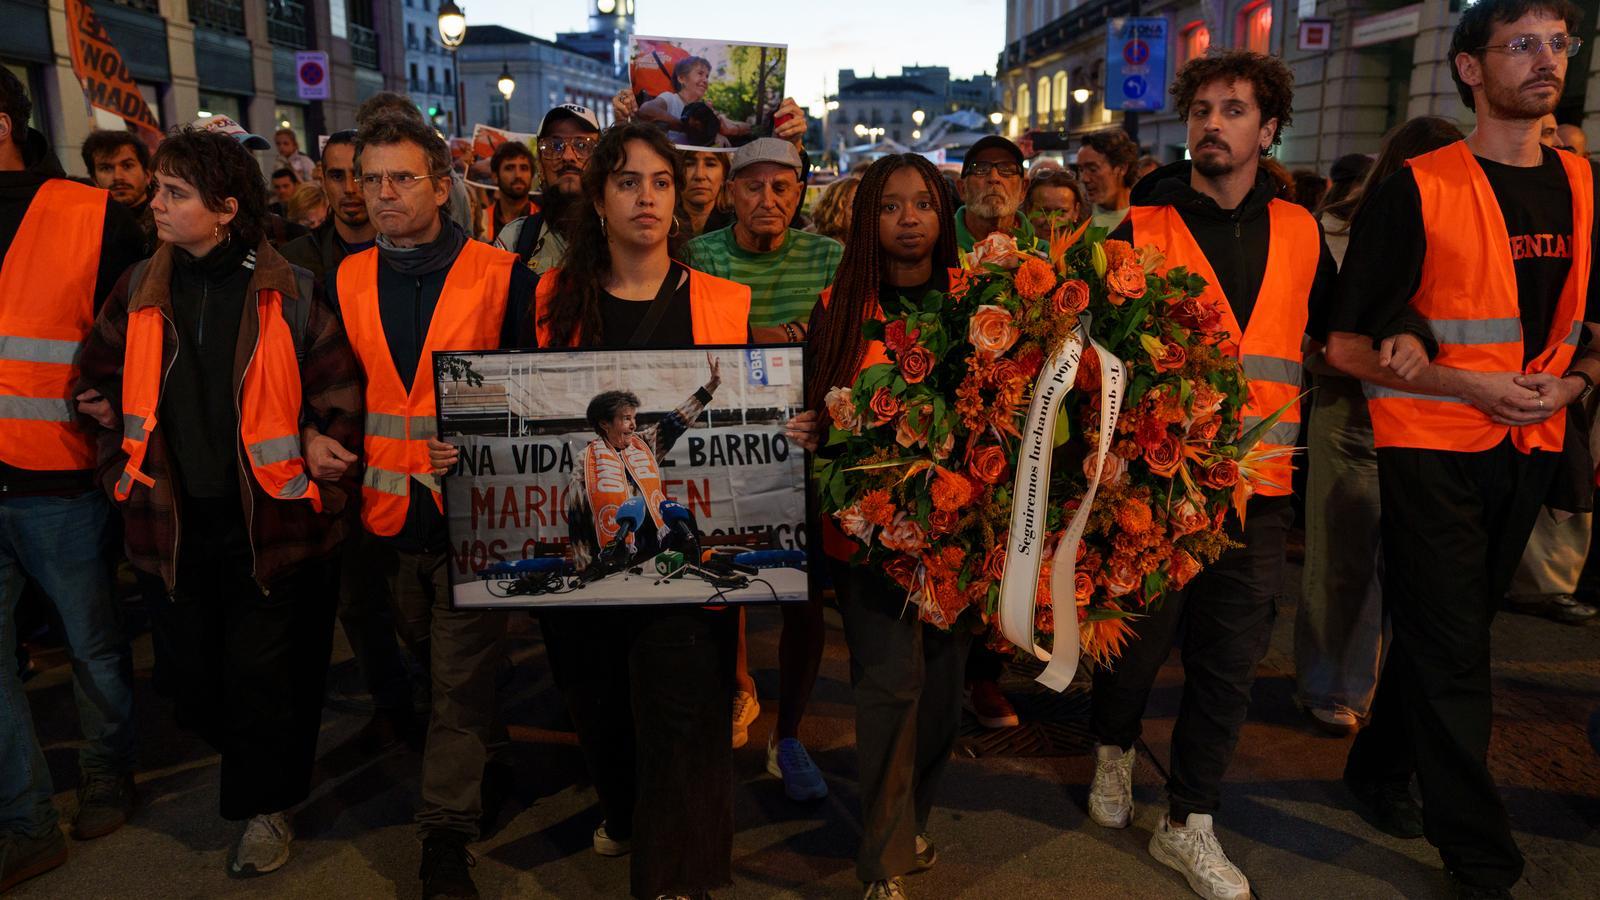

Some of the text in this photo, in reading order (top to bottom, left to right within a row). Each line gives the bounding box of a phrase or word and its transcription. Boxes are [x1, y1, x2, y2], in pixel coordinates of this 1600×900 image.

[1110, 365, 1120, 385] Te
[511, 442, 574, 474] VIDA
[687, 431, 790, 467] BARRIO
[1018, 349, 1080, 556] Seguiremos luchando por ti
